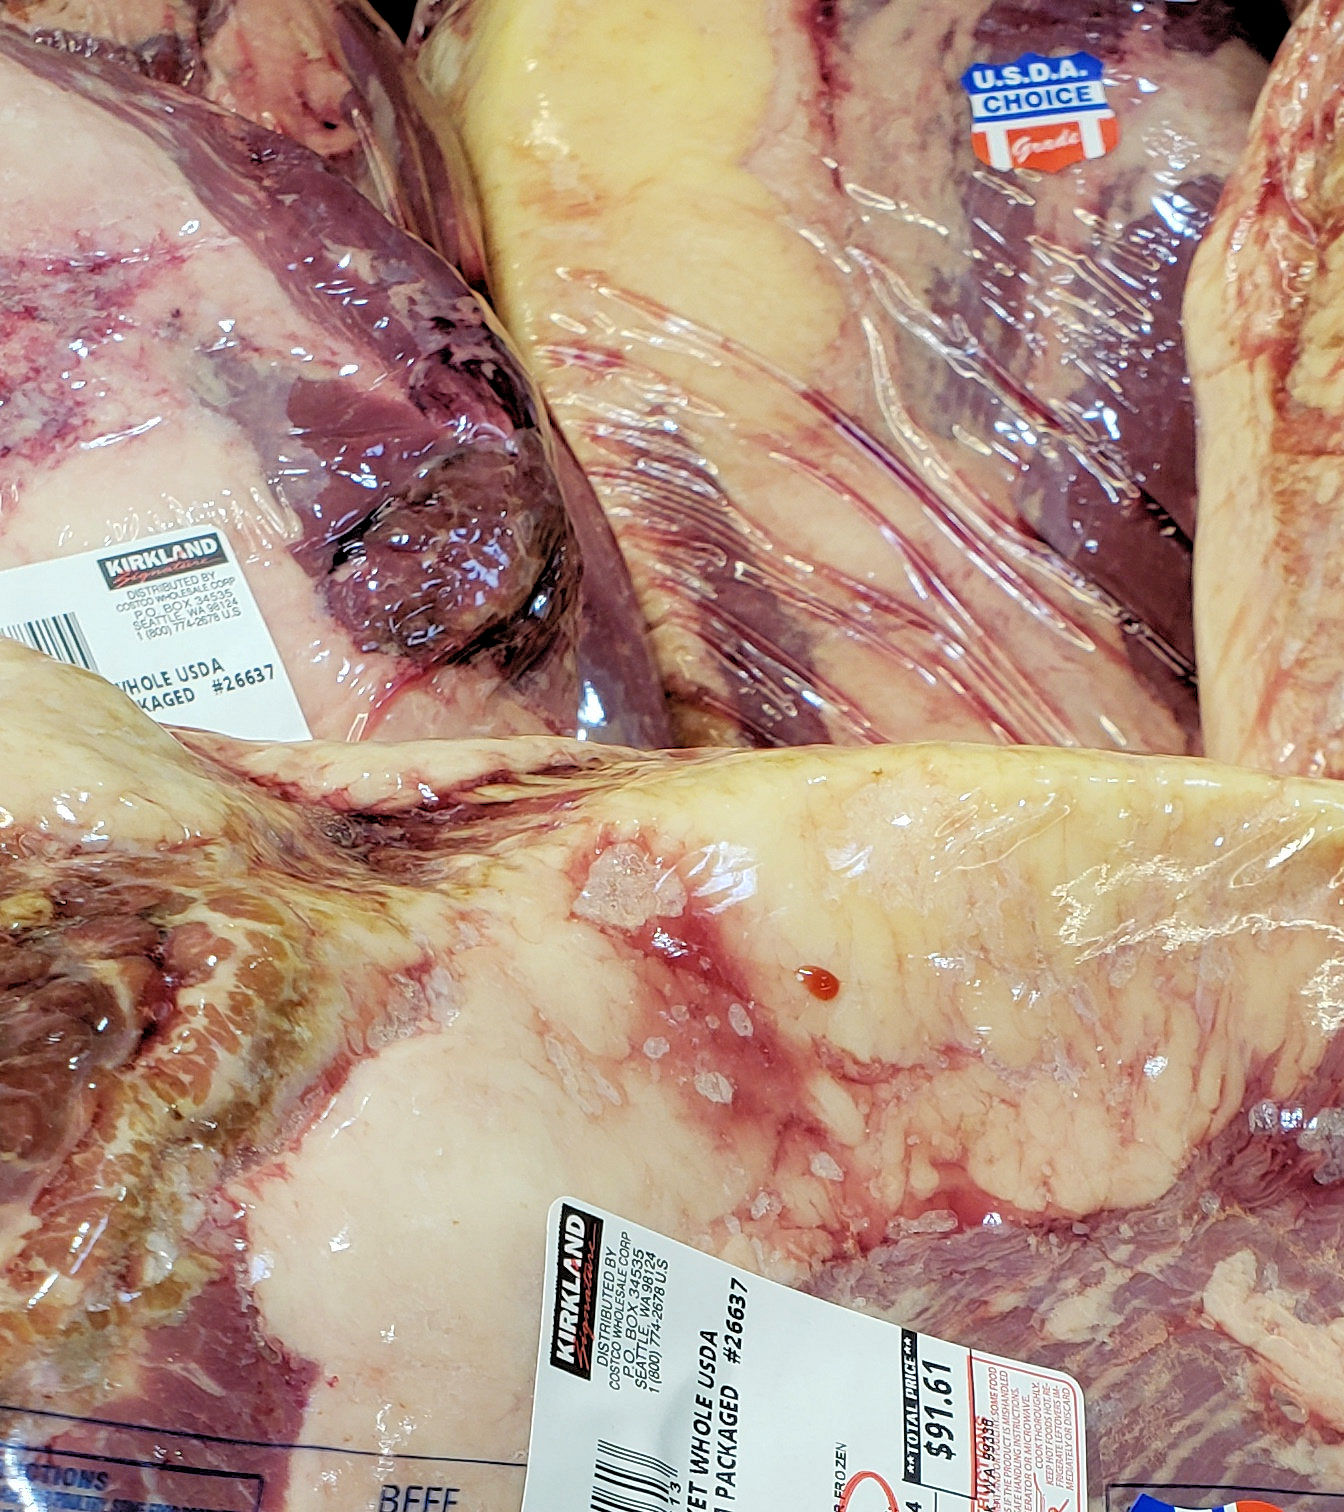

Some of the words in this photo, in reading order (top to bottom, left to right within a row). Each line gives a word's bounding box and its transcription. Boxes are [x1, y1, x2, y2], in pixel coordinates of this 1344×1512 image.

[972, 59, 1088, 89] U.S.D.A.
[983, 86, 1093, 113] CHOICE
[105, 538, 218, 577] KIRKLAND
[115, 596, 155, 612] COSTCO
[156, 584, 209, 603] WHOLESALE
[127, 577, 199, 599] DISTRIBUTED
[200, 570, 217, 582] BY
[162, 598, 192, 613] BOX
[193, 588, 234, 605] 34535
[186, 605, 206, 617] WA
[175, 657, 225, 682] USDA
[212, 663, 274, 695] #26637
[604, 1245, 617, 1268] BY
[617, 1230, 631, 1266] CORP
[555, 1214, 587, 1363] KIRKLAND
[628, 1247, 645, 1299] 34535
[641, 1250, 656, 1293] 98124
[574, 1222, 599, 1370] Signature
[611, 1267, 627, 1338] WHOLESALE
[639, 1295, 652, 1317] WA
[649, 1285, 665, 1347] 774-2678
[596, 1270, 618, 1367] DISTRIBUTED
[624, 1300, 639, 1340] BOX
[722, 1276, 748, 1364] #26637
[608, 1340, 622, 1390] COSTCO
[622, 1347, 638, 1378] P.O.
[634, 1323, 654, 1390] SEATTLE,
[644, 1349, 662, 1384] (800)
[696, 1329, 718, 1389] USDA
[922, 1359, 957, 1461] $91.61
[688, 1392, 713, 1474] WHOLE
[714, 1384, 739, 1500] PACKAGED
[833, 1443, 847, 1499] FROZEN
[983, 1465, 994, 1495] WA
